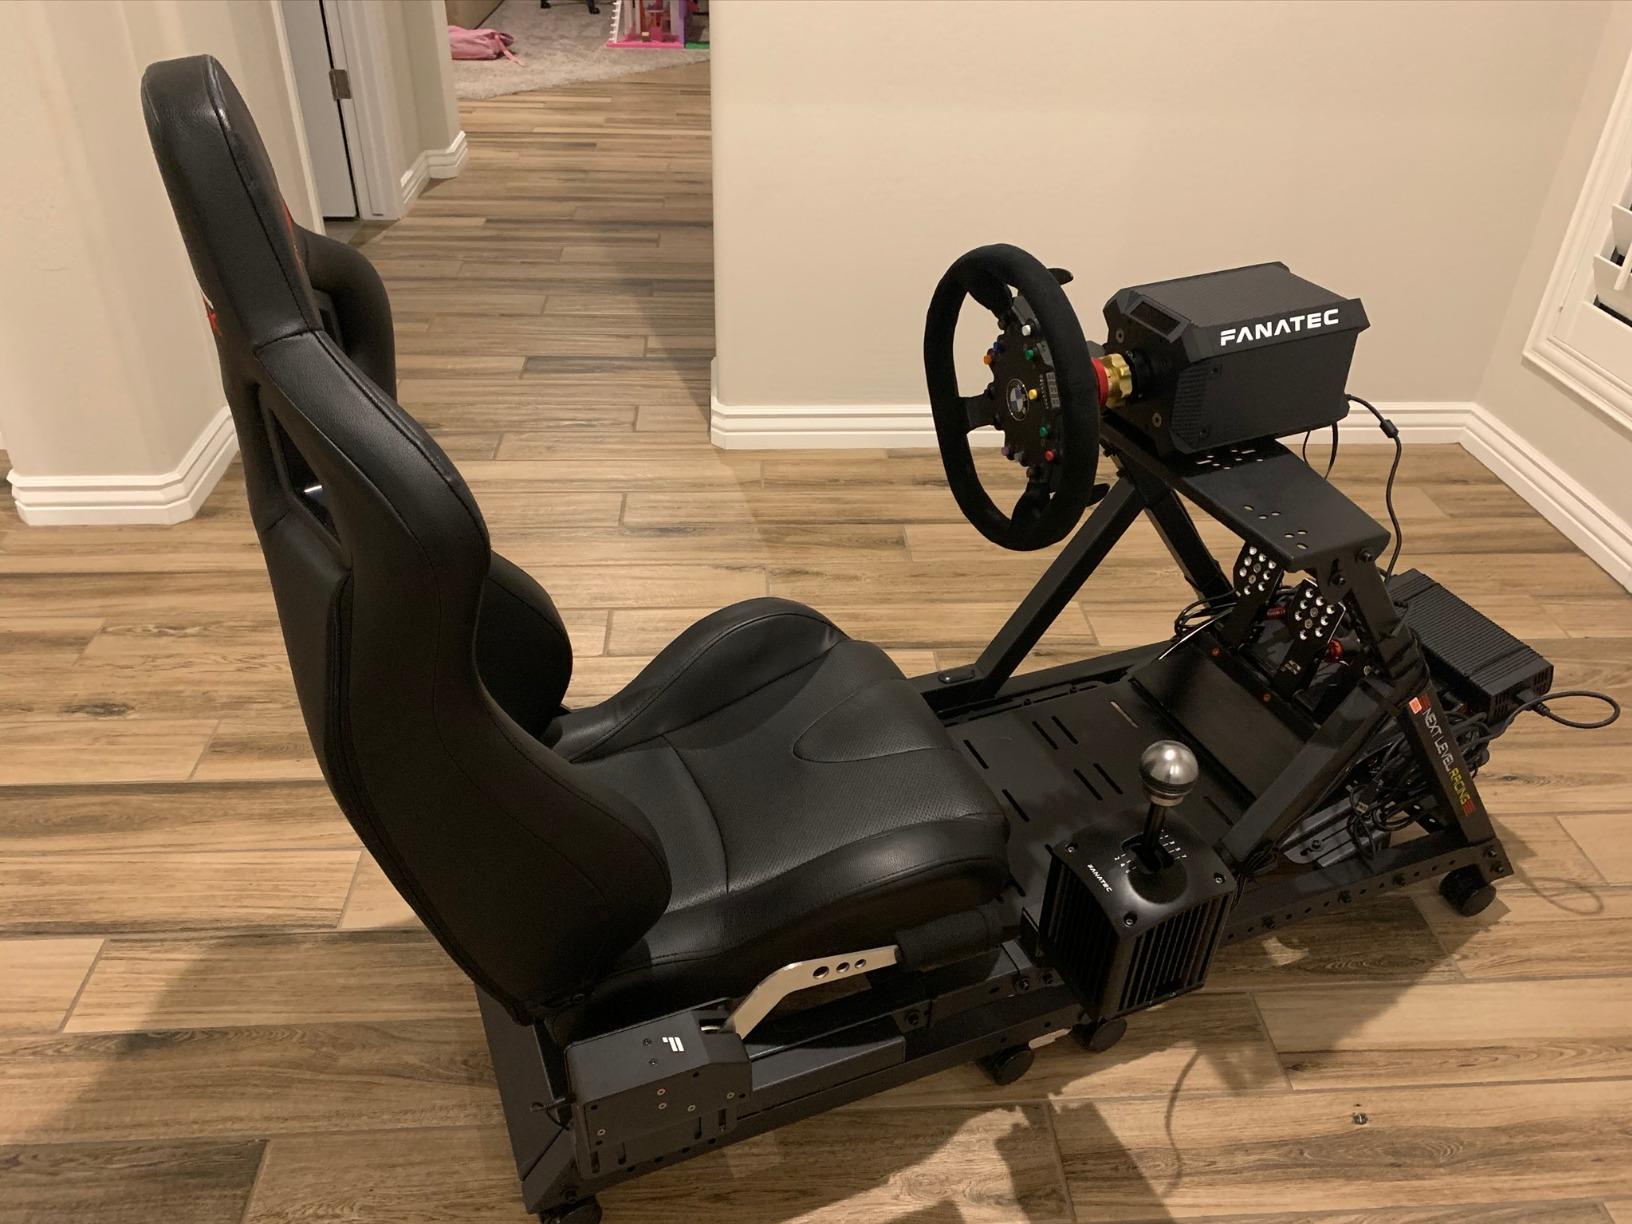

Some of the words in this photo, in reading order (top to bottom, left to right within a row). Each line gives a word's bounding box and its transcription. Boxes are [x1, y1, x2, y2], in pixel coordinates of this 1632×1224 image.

[1220, 308, 1339, 346] FANATEC
[1422, 708, 1442, 738] NEXT
[1434, 736, 1454, 772] LEVEL
